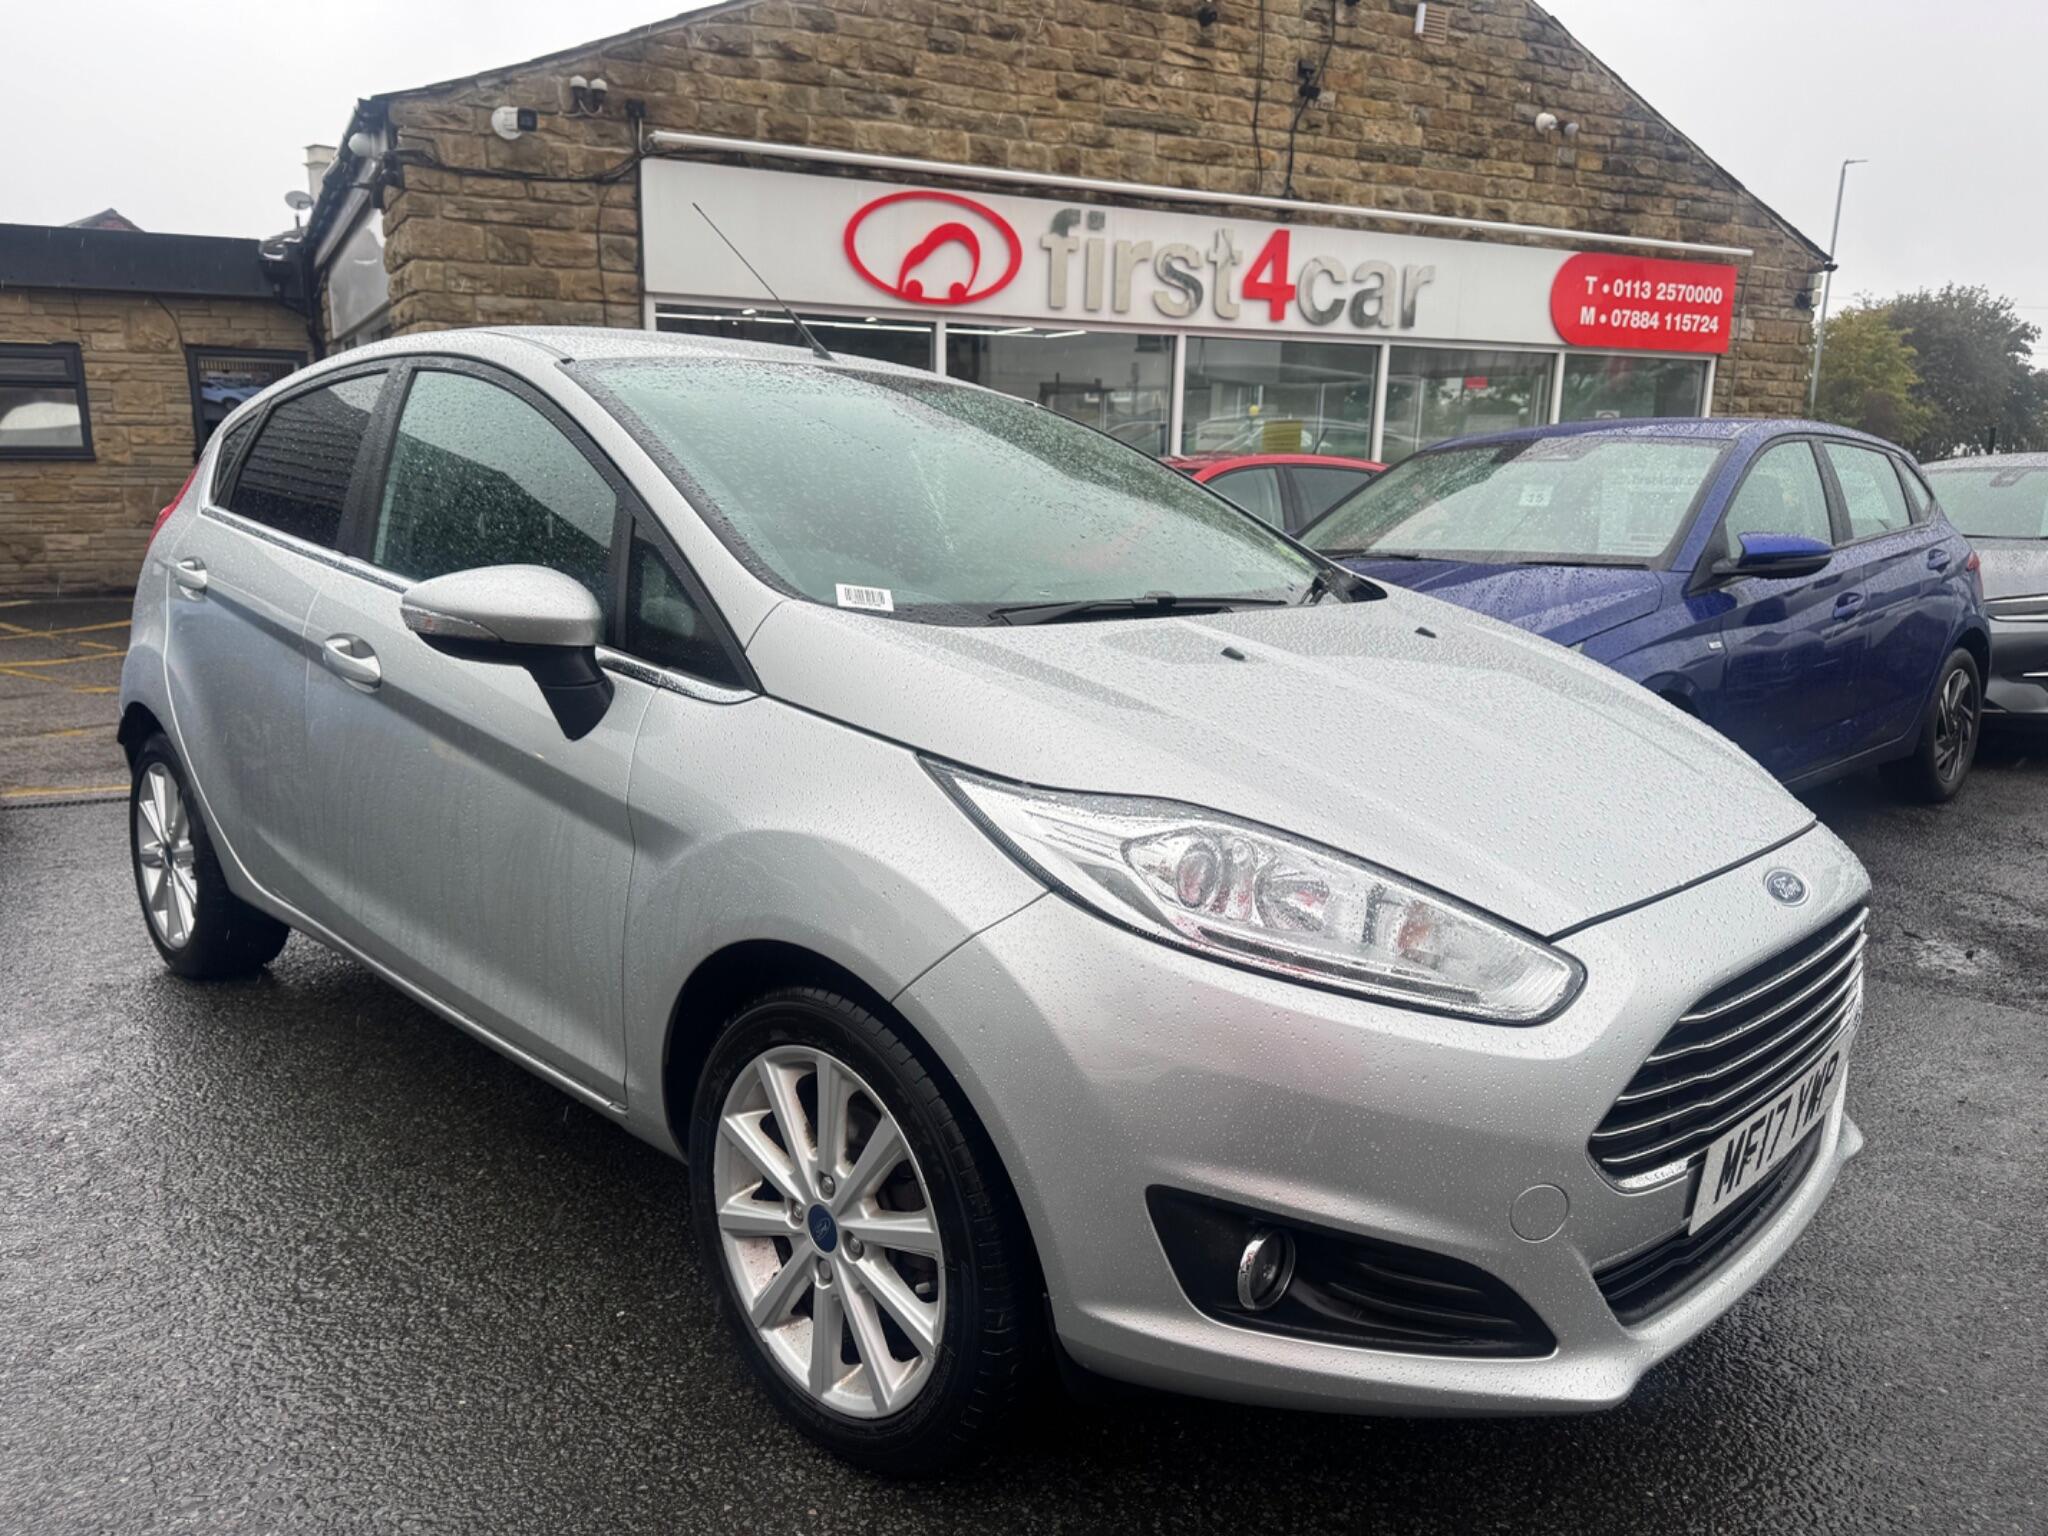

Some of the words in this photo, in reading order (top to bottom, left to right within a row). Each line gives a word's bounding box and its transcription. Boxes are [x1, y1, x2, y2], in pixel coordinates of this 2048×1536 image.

[1041, 208, 1437, 329] first4car
[1584, 275, 1598, 295] T
[1612, 279, 1651, 299] 0113
[1656, 282, 1723, 305] 2570000
[1580, 306, 1596, 326] M
[1610, 309, 1660, 330] 07884
[1664, 313, 1720, 333] 115724
[1713, 1093, 1793, 1204] MF17
[1791, 1051, 1840, 1139] YWP
